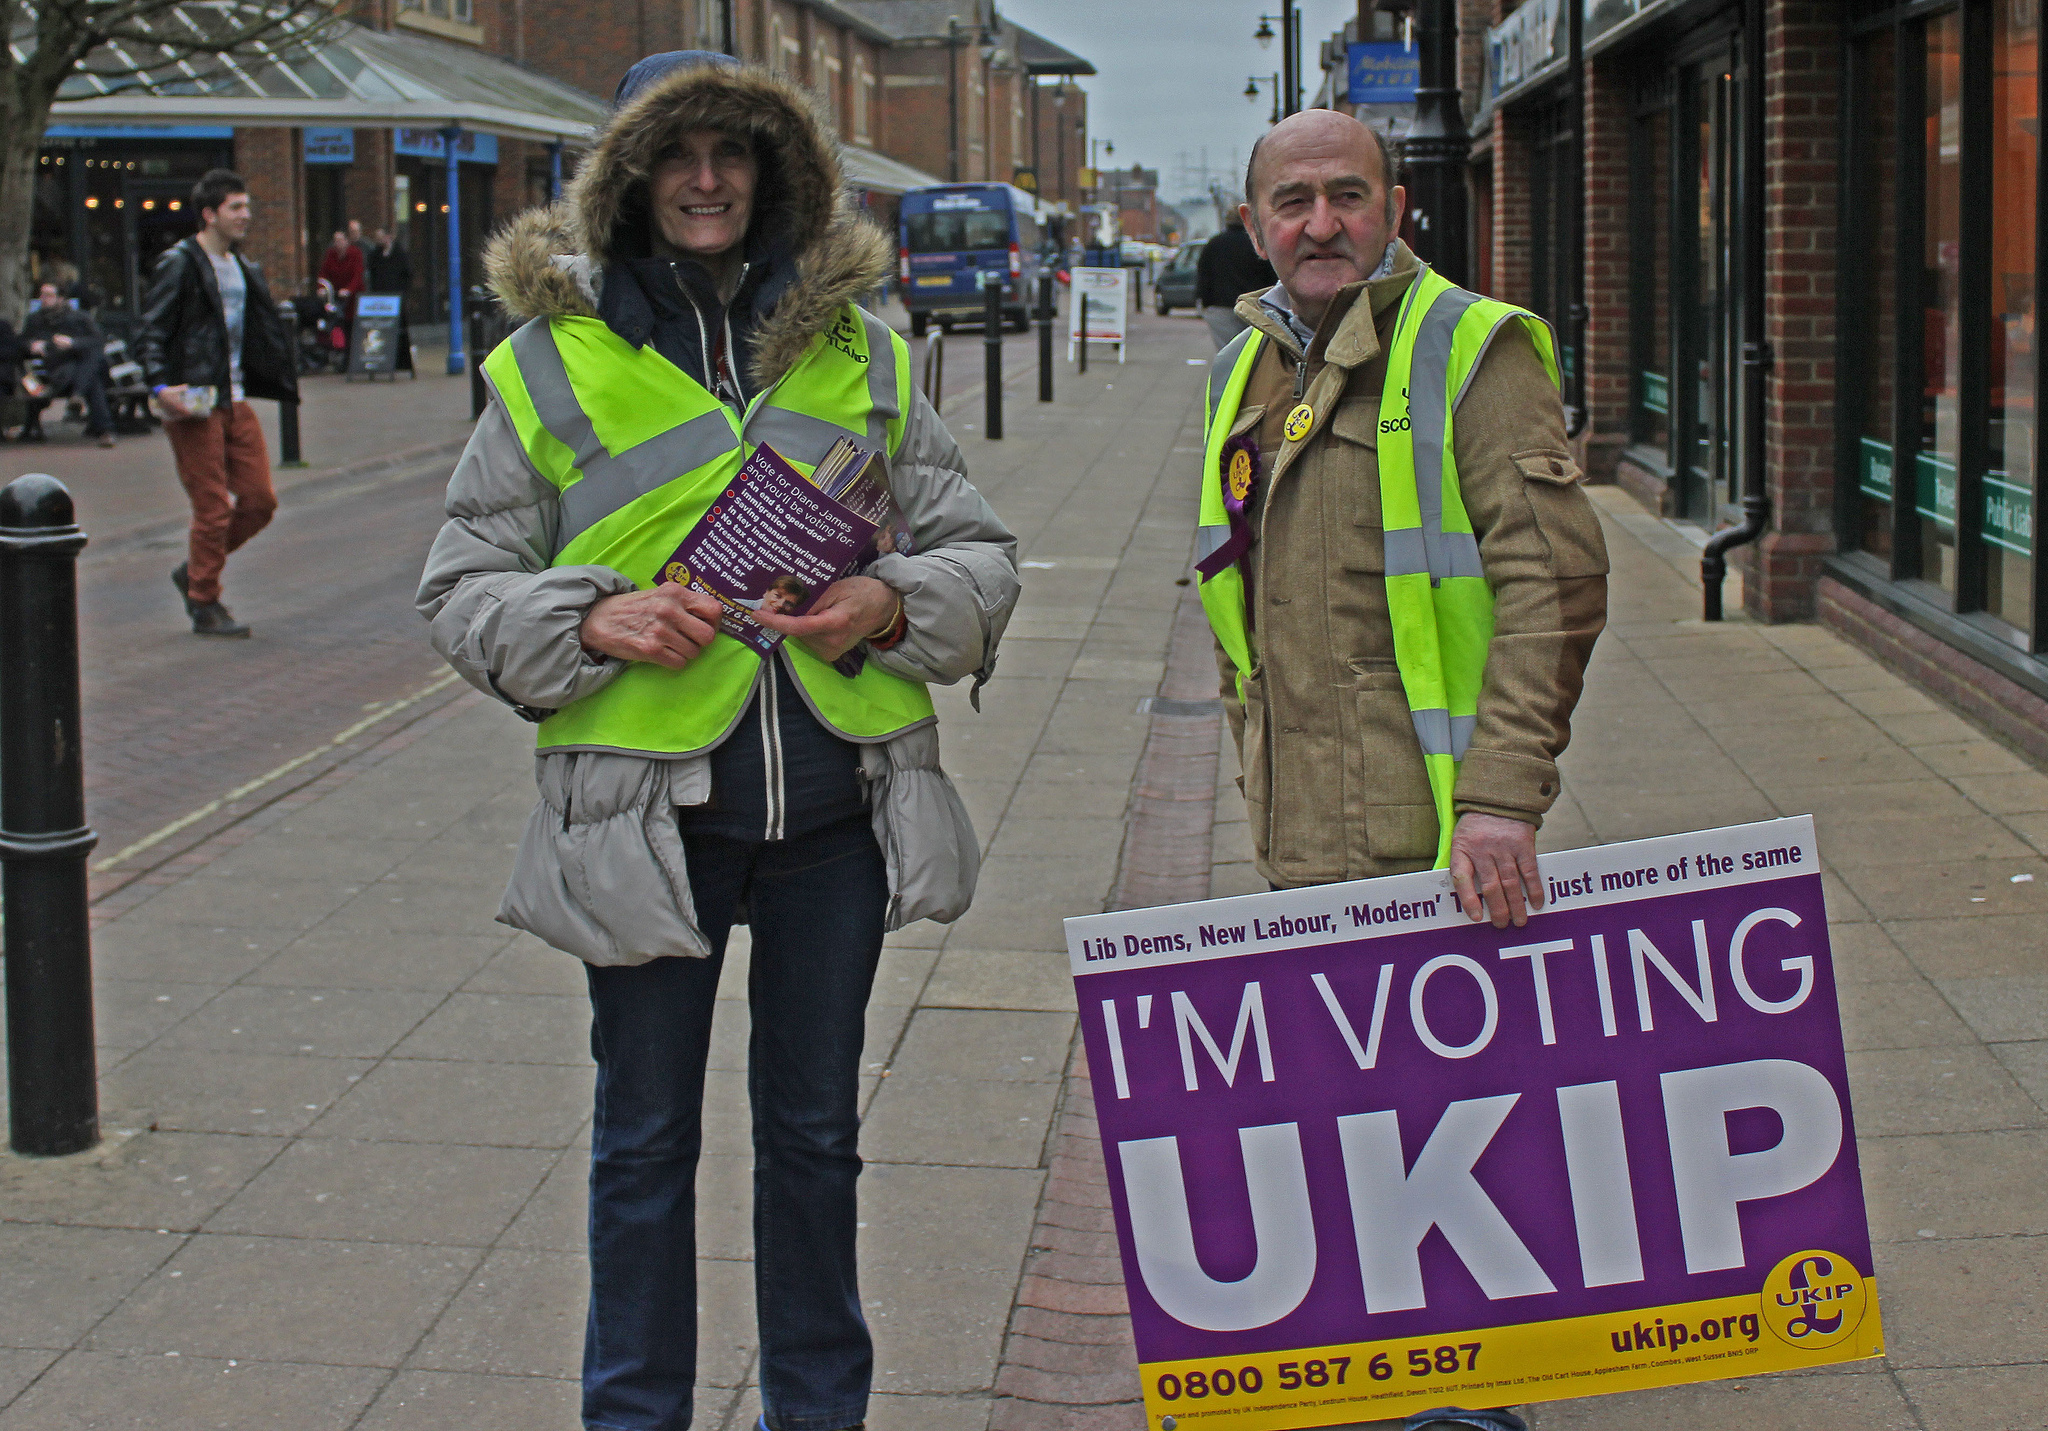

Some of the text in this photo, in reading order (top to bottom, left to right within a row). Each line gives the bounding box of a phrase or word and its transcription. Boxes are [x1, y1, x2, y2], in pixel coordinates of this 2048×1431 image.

[1380, 417, 1411, 433] SCO
[741, 488, 787, 530] immigration
[746, 464, 766, 482] and
[790, 501, 804, 515] be
[804, 512, 836, 537] voting
[836, 532, 855, 548] for:
[746, 481, 828, 543] An end to open-door
[755, 453, 776, 476] Vote
[775, 473, 791, 488] for
[790, 487, 819, 511] Diane
[818, 510, 853, 533] James
[701, 538, 746, 578] benefits for
[708, 530, 755, 571] housing and
[714, 522, 776, 572] Preserving local
[720, 513, 818, 586] No tax on minimum wage
[727, 505, 737, 516] in
[736, 514, 752, 530] key
[750, 526, 793, 562] industries,
[794, 557, 810, 570] like
[810, 568, 832, 581] Ford
[734, 496, 760, 522] Saving
[760, 520, 818, 564] manufacturing
[816, 560, 837, 573] jobs
[688, 554, 706, 572] first
[694, 546, 749, 592] British people
[1083, 938, 1117, 962] Lib
[1124, 933, 1192, 956] Dems,
[1199, 924, 1246, 948] New
[1254, 914, 1338, 940] Labour,
[1548, 871, 1594, 905] just
[1601, 867, 1658, 892] more
[1666, 856, 1689, 882] of
[1696, 853, 1734, 878] the
[1742, 844, 1802, 870] same
[1311, 907, 1815, 1071] VOTING
[1117, 1058, 1844, 1332] UKIP
[1776, 1283, 1854, 1307] UKIP
[1610, 1312, 1761, 1352] ukip.org
[1157, 1342, 1482, 1401] 0800 587 6 587
[1554, 1370, 1569, 1379] Cart
[1702, 1350, 1726, 1360] Sussex
